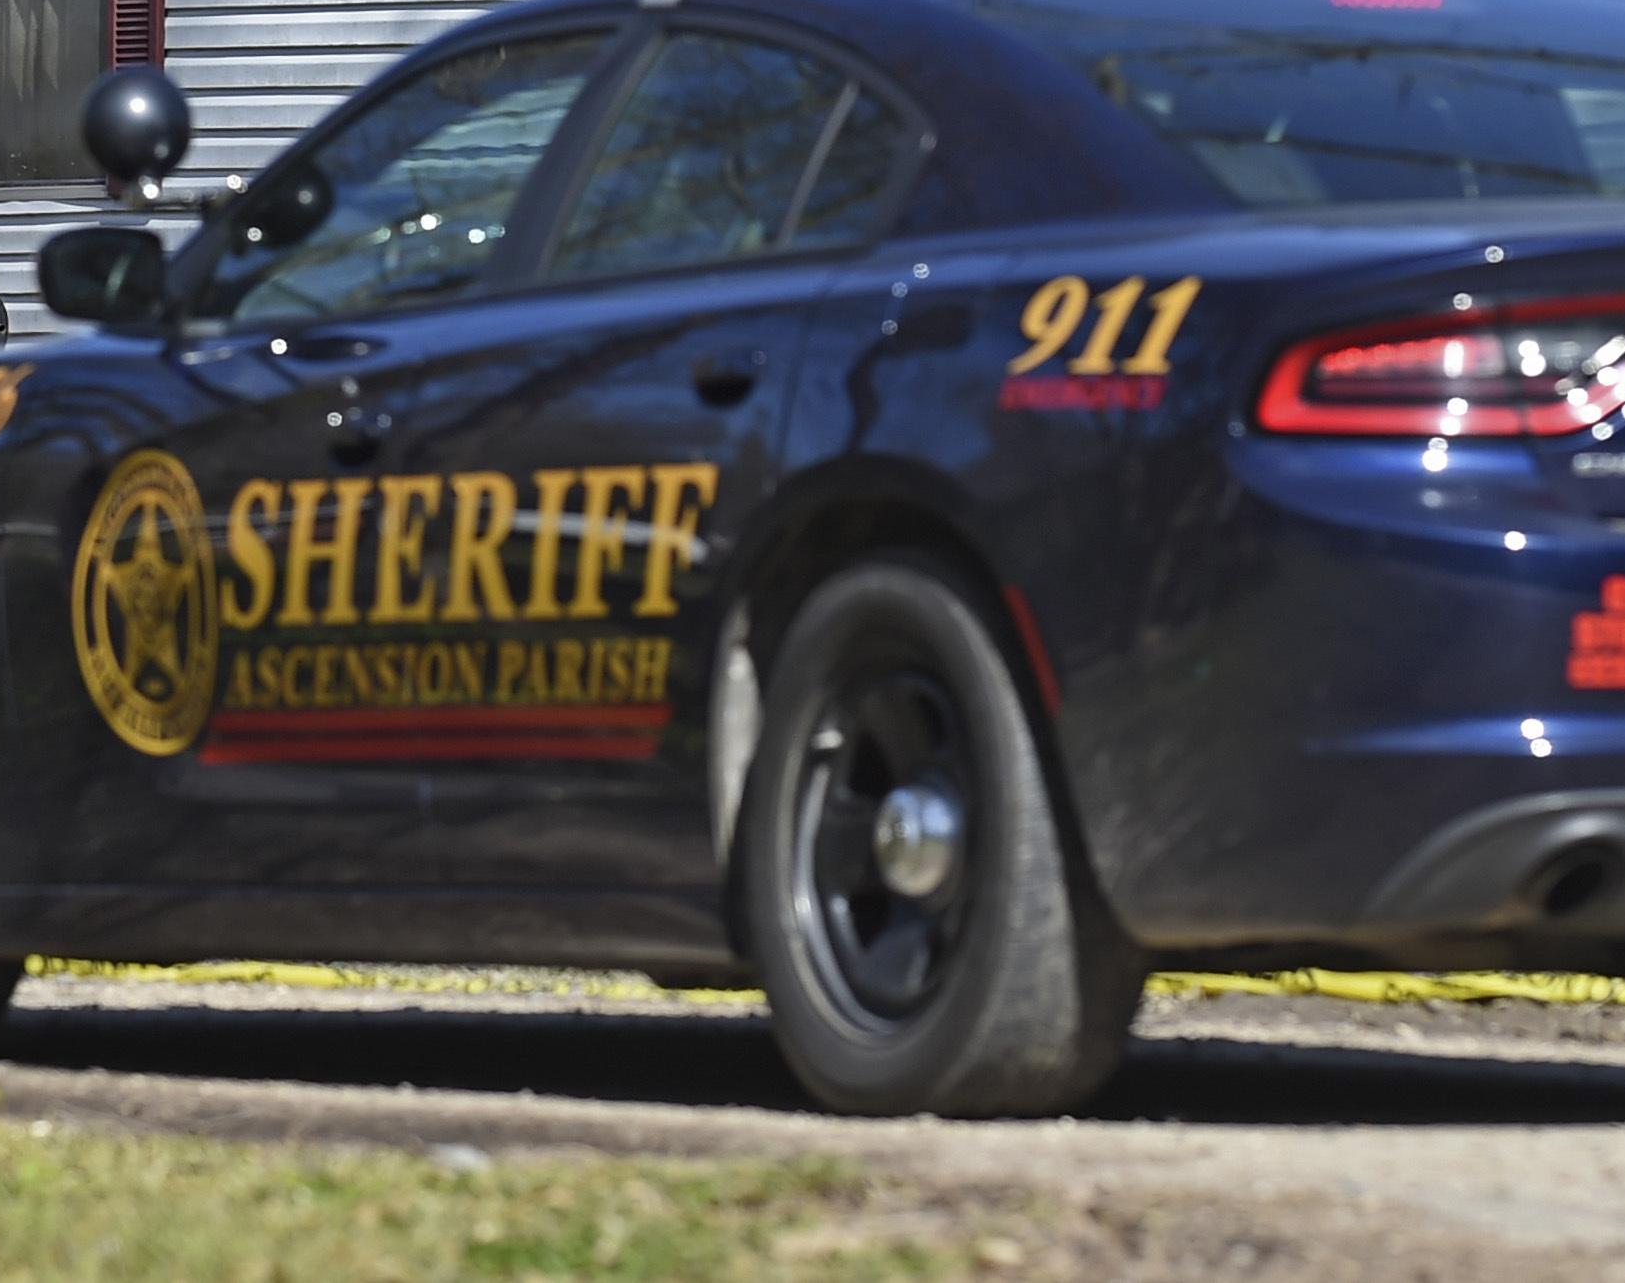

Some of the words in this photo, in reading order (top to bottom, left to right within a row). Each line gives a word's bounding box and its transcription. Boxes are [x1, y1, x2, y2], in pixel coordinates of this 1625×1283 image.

[1006, 275, 1202, 375] 911
[220, 463, 719, 629] SHERIFF
[225, 643, 486, 708] ASCENSION
[494, 637, 673, 703] PARISH
